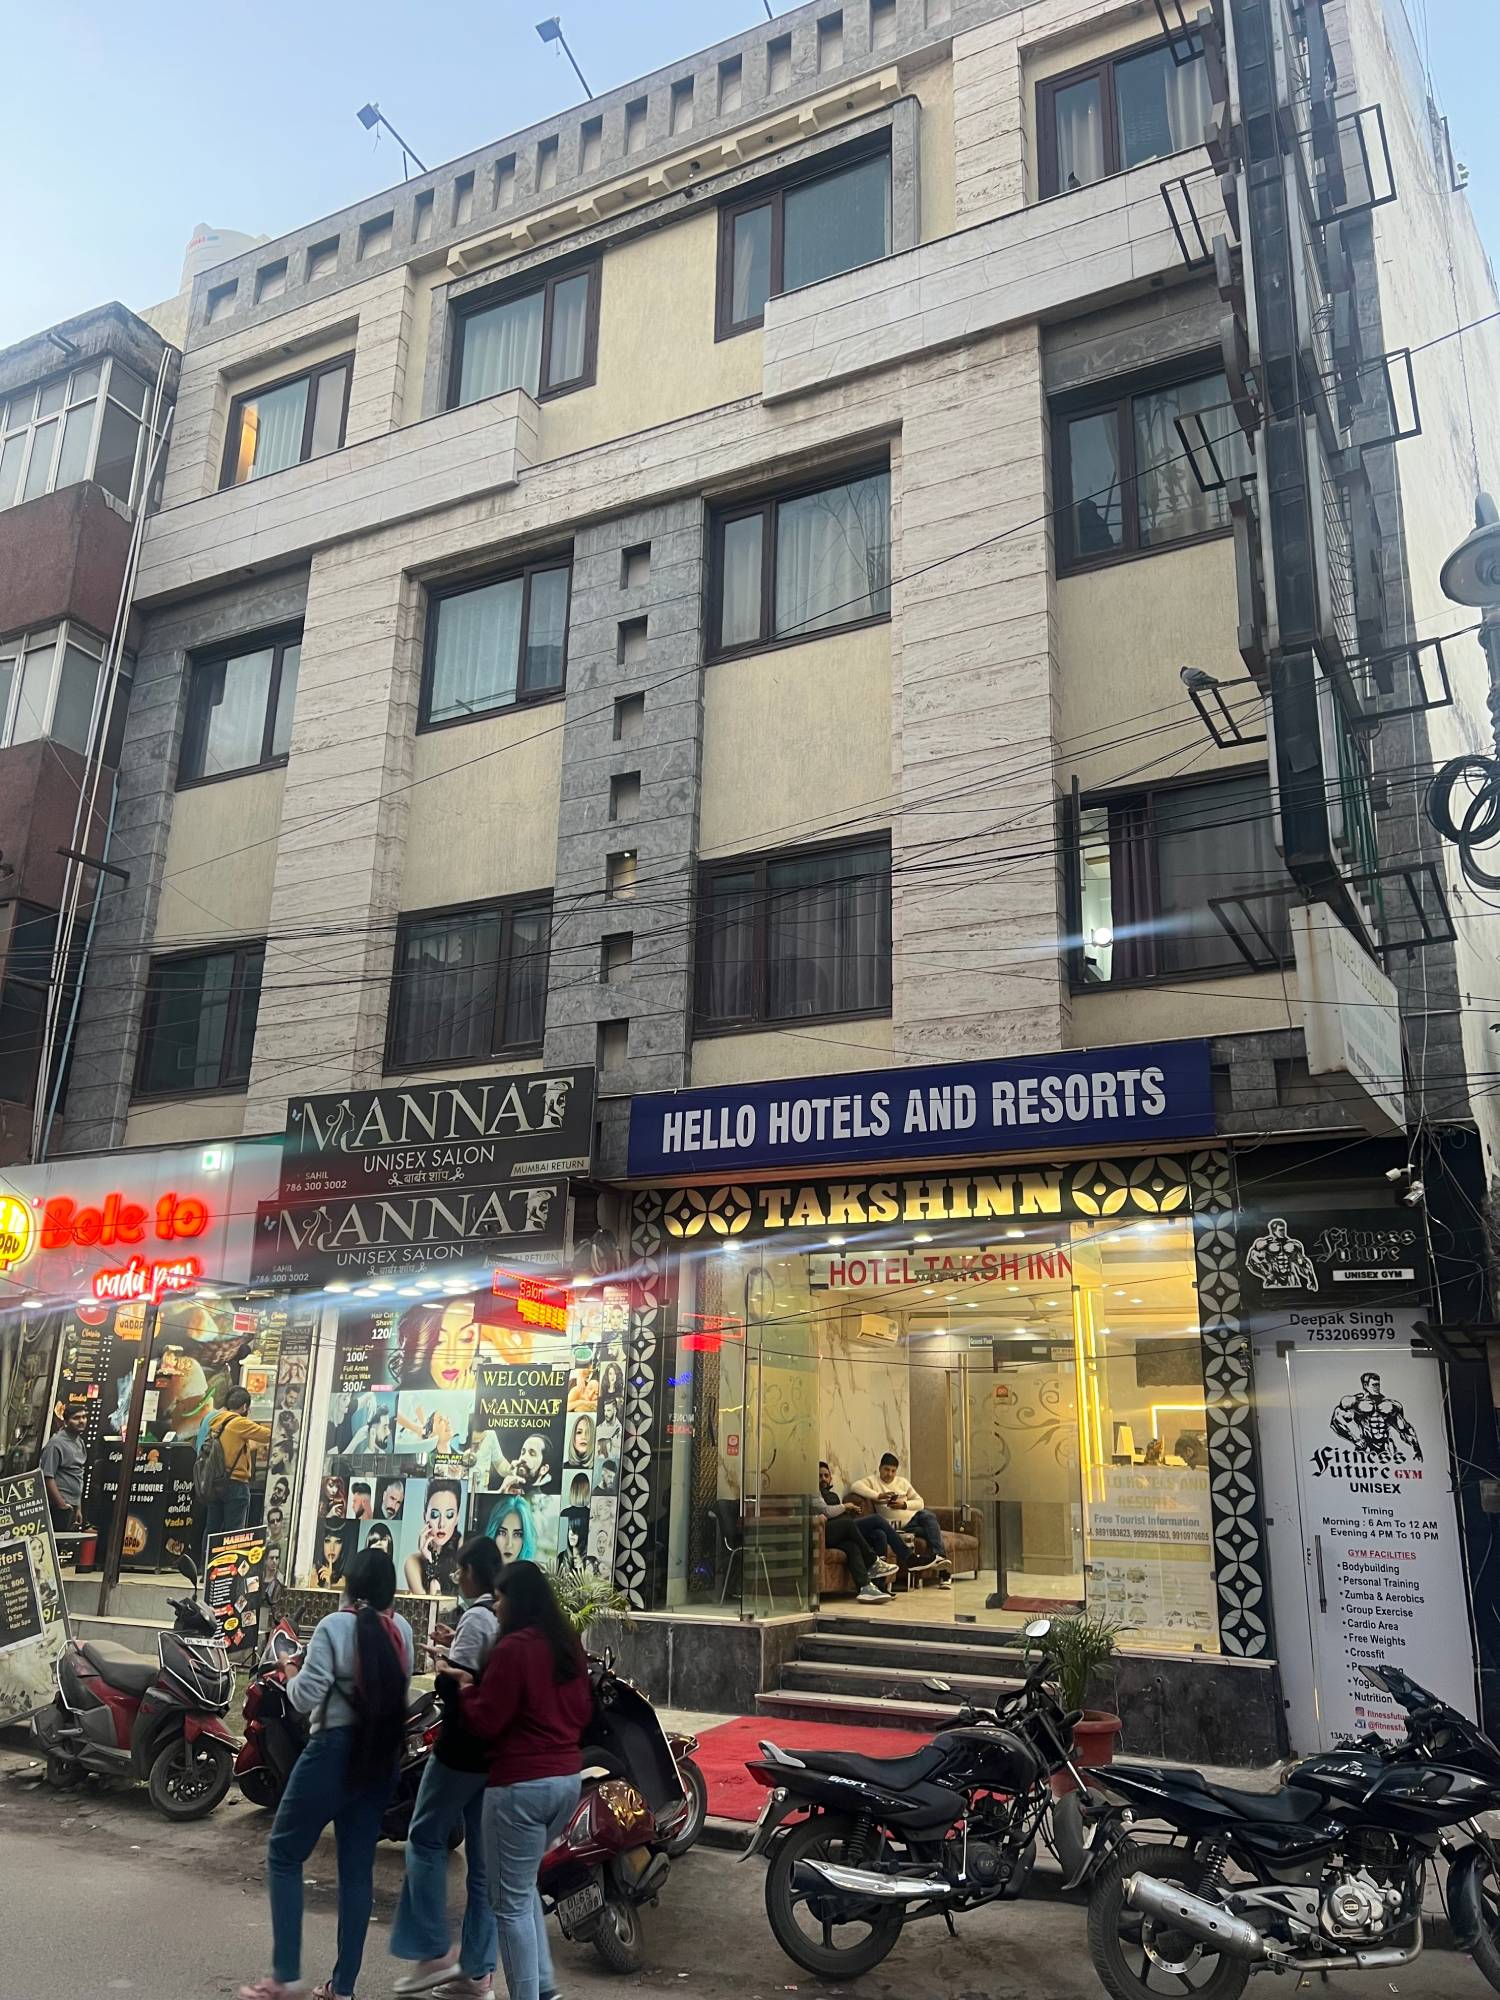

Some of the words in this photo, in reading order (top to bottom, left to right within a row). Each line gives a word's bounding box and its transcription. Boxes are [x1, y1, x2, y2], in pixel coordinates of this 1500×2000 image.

[300, 1076, 574, 1153] MANNAT
[662, 1104, 756, 1154] HELLO
[769, 1091, 890, 1145] HOTELS
[903, 1084, 976, 1134] AND
[992, 1066, 1166, 1127] RESORTS
[364, 1151, 425, 1173] UNISEX
[432, 1145, 495, 1165] SALON
[514, 1162, 549, 1175] MUMBAI
[551, 1159, 585, 1171] RETURN
[305, 1170, 329, 1180] SAHIL
[285, 1182, 302, 1192] 786
[305, 1181, 322, 1191] 300
[324, 1179, 347, 1190] 3002
[41, 1193, 148, 1249] Bole
[155, 1192, 207, 1240] to
[277, 1186, 558, 1252] MANNAT
[336, 1248, 397, 1266] UNISEX
[403, 1244, 464, 1262] SALON
[830, 1251, 917, 1286] HOTEL
[924, 1253, 1019, 1283] TAKSH
[1028, 1250, 1073, 1280] INN
[1344, 1270, 1378, 1279] UNISEX
[1381, 1269, 1403, 1279] GYM
[96, 1261, 145, 1297] vada
[151, 1262, 193, 1302] pav
[272, 1273, 286, 1283] 300
[289, 1273, 309, 1282] 3002
[519, 1281, 544, 1301] Salon
[1290, 1314, 1345, 1327] Deepak
[1350, 1312, 1394, 1326] Singh
[371, 1328, 396, 1340] 120/-
[1306, 1328, 1396, 1341] 7532069979
[346, 1351, 368, 1362] 100/-
[483, 1370, 565, 1387] WELCOME
[342, 1381, 366, 1392] 300/-
[480, 1398, 562, 1416] MANNAT
[488, 1419, 518, 1427] UNISEX
[521, 1418, 551, 1427] SALON
[1309, 1446, 1407, 1468] Fitness
[1394, 1469, 1423, 1479] GYM
[138, 1483, 164, 1493] INQUIRE
[1127, 1473, 1176, 1489] HOTELS
[1180, 1474, 1208, 1490] AND
[1350, 1482, 1402, 1494] UNISEX
[15, 1498, 43, 1511] MUMBAI
[1119, 1495, 1177, 1509] RESORTS
[19, 1505, 44, 1517] RETURN
[1362, 1506, 1394, 1517] Timing
[165, 1518, 184, 1528] Vada
[1094, 1513, 1113, 1524] Free
[1116, 1514, 1146, 1525] Tourist
[1148, 1514, 1200, 1527] Information
[1322, 1517, 1360, 1527] Morning
[1376, 1520, 1392, 1528] Am
[1395, 1520, 1406, 1529] To
[1409, 1520, 1420, 1528] 12
[1422, 1521, 1438, 1529] AM
[12, 1519, 46, 1537] 999/-
[1330, 1527, 1368, 1539] Evening
[1378, 1530, 1393, 1538] PM
[1397, 1530, 1408, 1539] To
[1411, 1531, 1421, 1539] 10
[1423, 1531, 1439, 1540] PM
[1348, 1549, 1367, 1558] GYM
[1370, 1551, 1417, 1560] FACILITIES
[1342, 1561, 1400, 1575] Bodybuilding
[1343, 1576, 1381, 1587] Personal
[1384, 1578, 1420, 1590] Training
[1345, 1590, 1374, 1600] Zumba
[1377, 1592, 1383, 1600] &
[1386, 1593, 1424, 1603] Aerobics
[1346, 1604, 1373, 1616] Group
[1376, 1606, 1413, 1617] Exercise
[1347, 1619, 1376, 1629] Cardio
[1378, 1621, 1399, 1631] Area
[1349, 1633, 1368, 1643] Free
[1370, 1634, 1406, 1647] Weights
[1350, 1647, 1385, 1659] Crossfit
[1354, 1692, 1393, 1703] Nutrition
